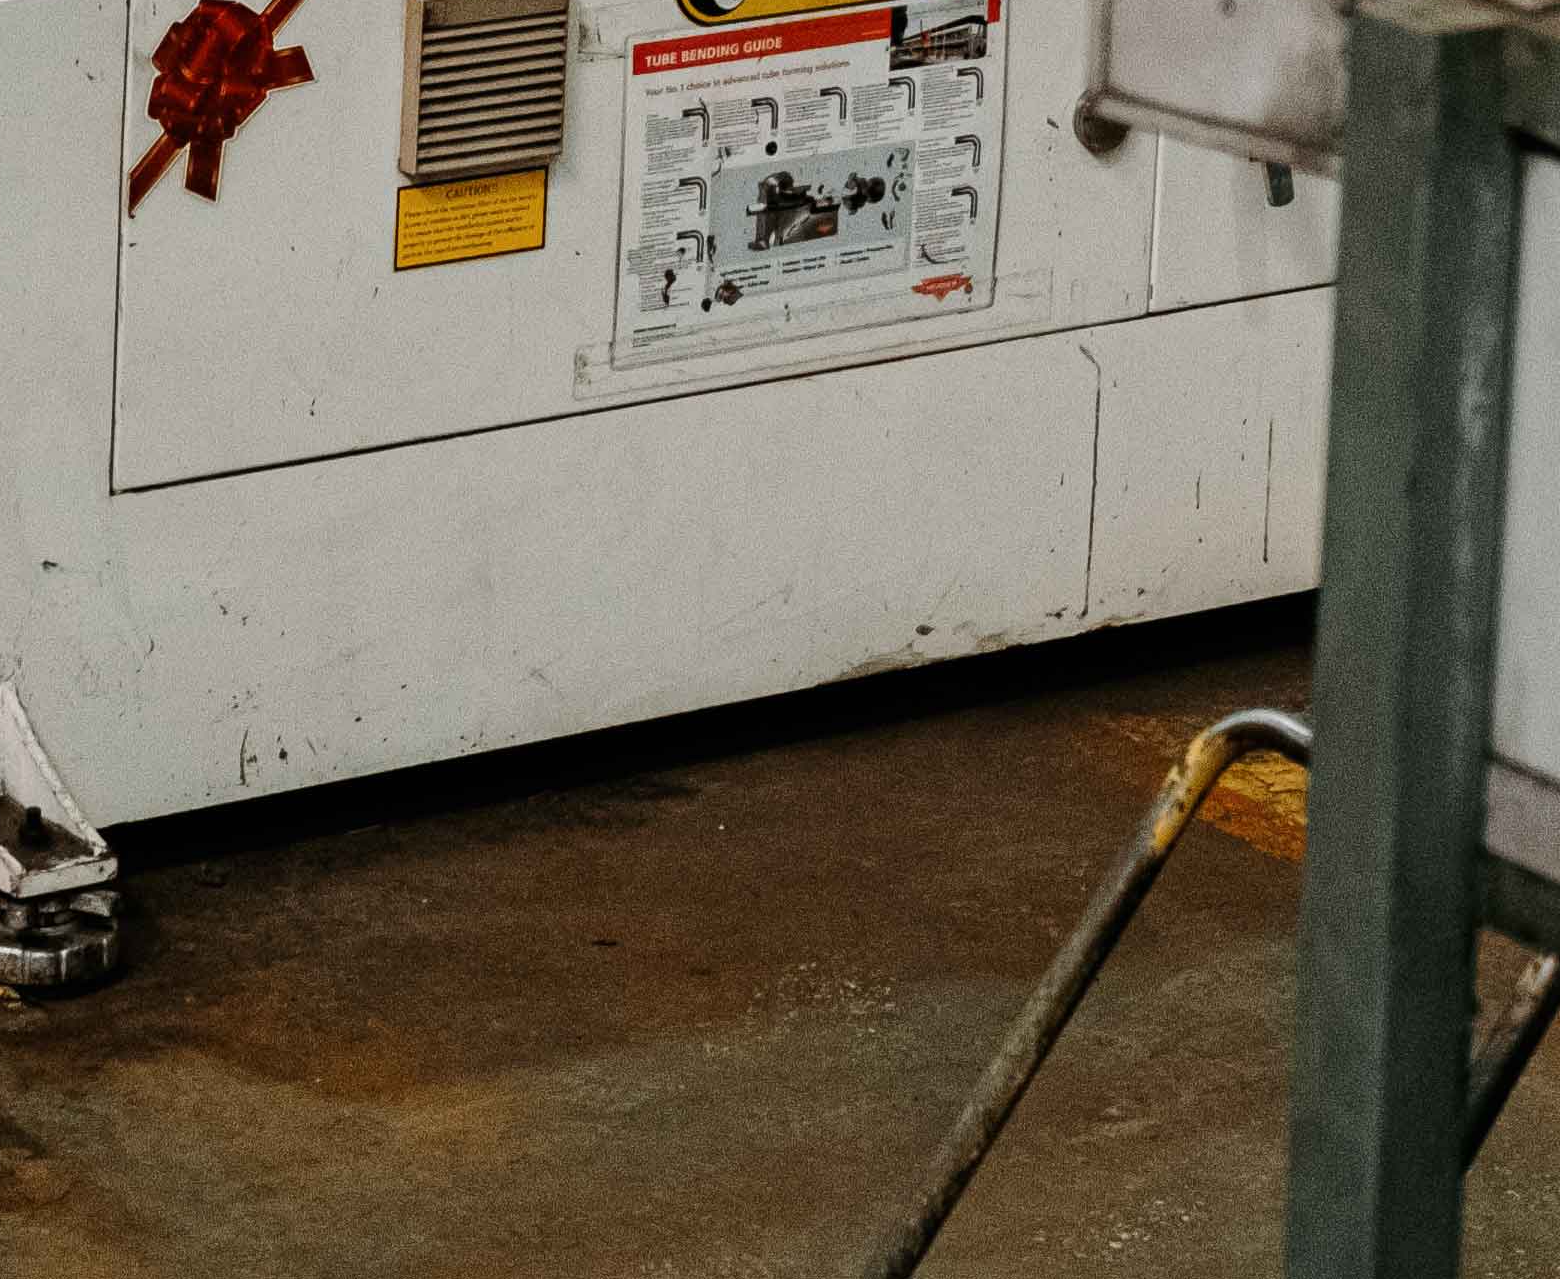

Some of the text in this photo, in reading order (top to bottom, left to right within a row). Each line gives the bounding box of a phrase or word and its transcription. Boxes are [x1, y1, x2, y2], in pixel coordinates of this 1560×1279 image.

[643, 36, 783, 67] TUBE BENDING GUIDE
